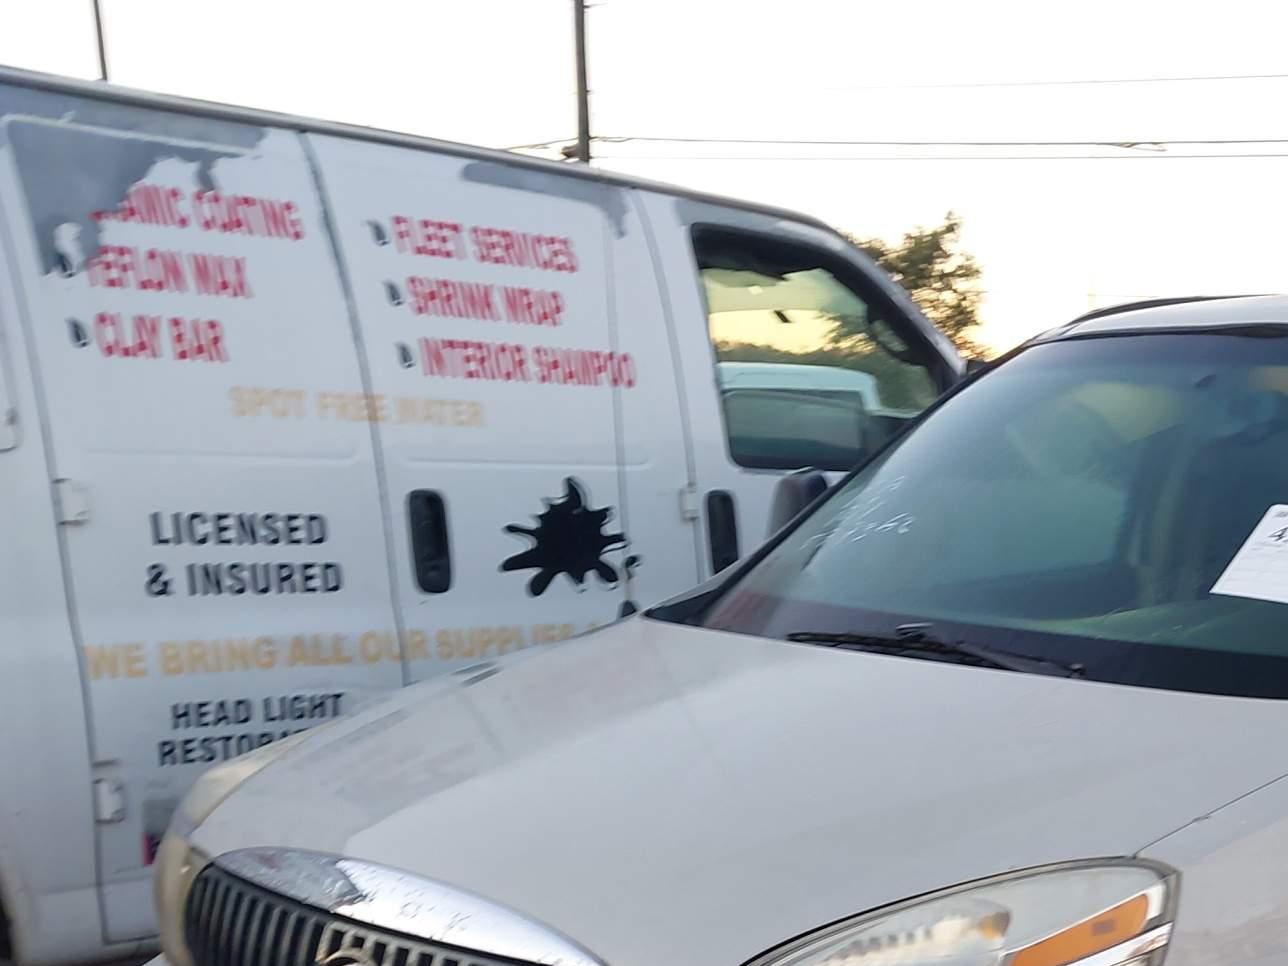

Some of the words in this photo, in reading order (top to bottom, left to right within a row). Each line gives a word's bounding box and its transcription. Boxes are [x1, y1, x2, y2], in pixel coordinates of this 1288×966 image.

[88, 183, 190, 228] AMIC
[193, 190, 304, 240] COATING
[391, 214, 468, 261] FLEET
[469, 225, 579, 273] SERVICES
[189, 253, 254, 299] WAX
[407, 275, 501, 321] SHRINK
[502, 286, 566, 327] WRAP
[94, 311, 162, 358] CLAY
[168, 317, 230, 363] BAR
[418, 336, 532, 382] INTERIOR
[532, 345, 638, 389] SHAMPOO
[230, 385, 306, 418] SPOT
[316, 391, 385, 422] FREE
[392, 396, 485, 427] WATER
[149, 511, 329, 545] LICENSED
[144, 562, 175, 598] &
[185, 561, 344, 597] INSURED
[84, 640, 149, 681] WE
[158, 634, 277, 678] BRING
[286, 631, 353, 668] ALL
[359, 628, 431, 665] OUR
[170, 698, 253, 731] HEAD
[263, 691, 347, 723] LIGHT
